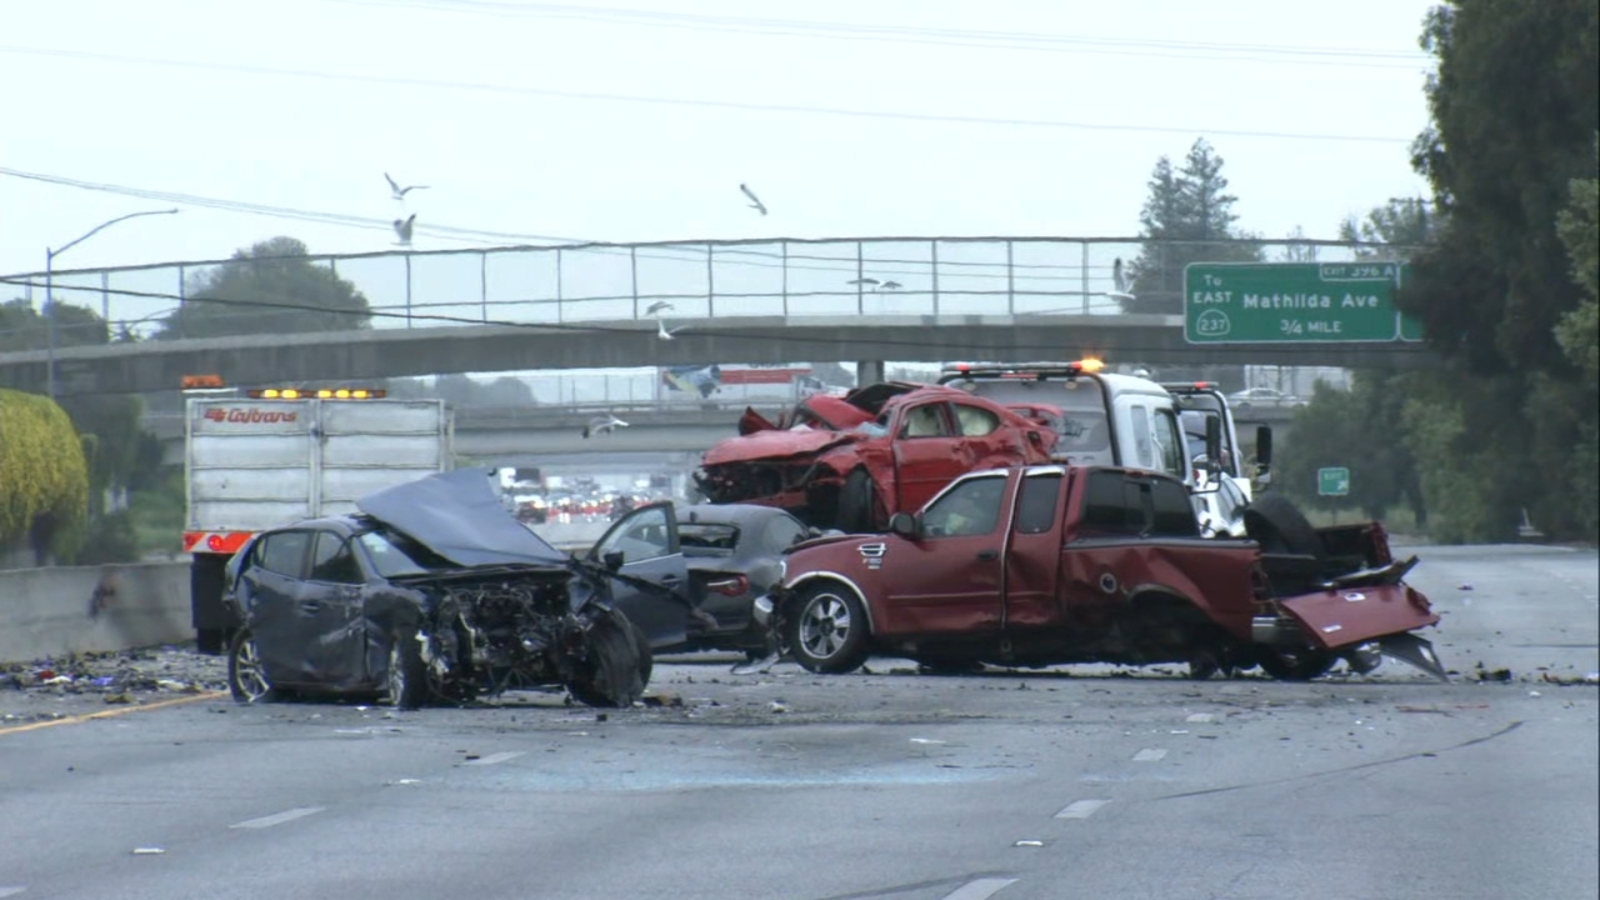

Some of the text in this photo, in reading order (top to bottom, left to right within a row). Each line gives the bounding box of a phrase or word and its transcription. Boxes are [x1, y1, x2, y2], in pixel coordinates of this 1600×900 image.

[1384, 266, 1395, 276] A
[1204, 275, 1223, 286] To
[1192, 292, 1233, 304] EAST
[1243, 294, 1379, 309] Mathilda Ave
[1200, 319, 1226, 332] 237
[1307, 321, 1343, 333] MILE
[228, 408, 296, 423] Caltrans
